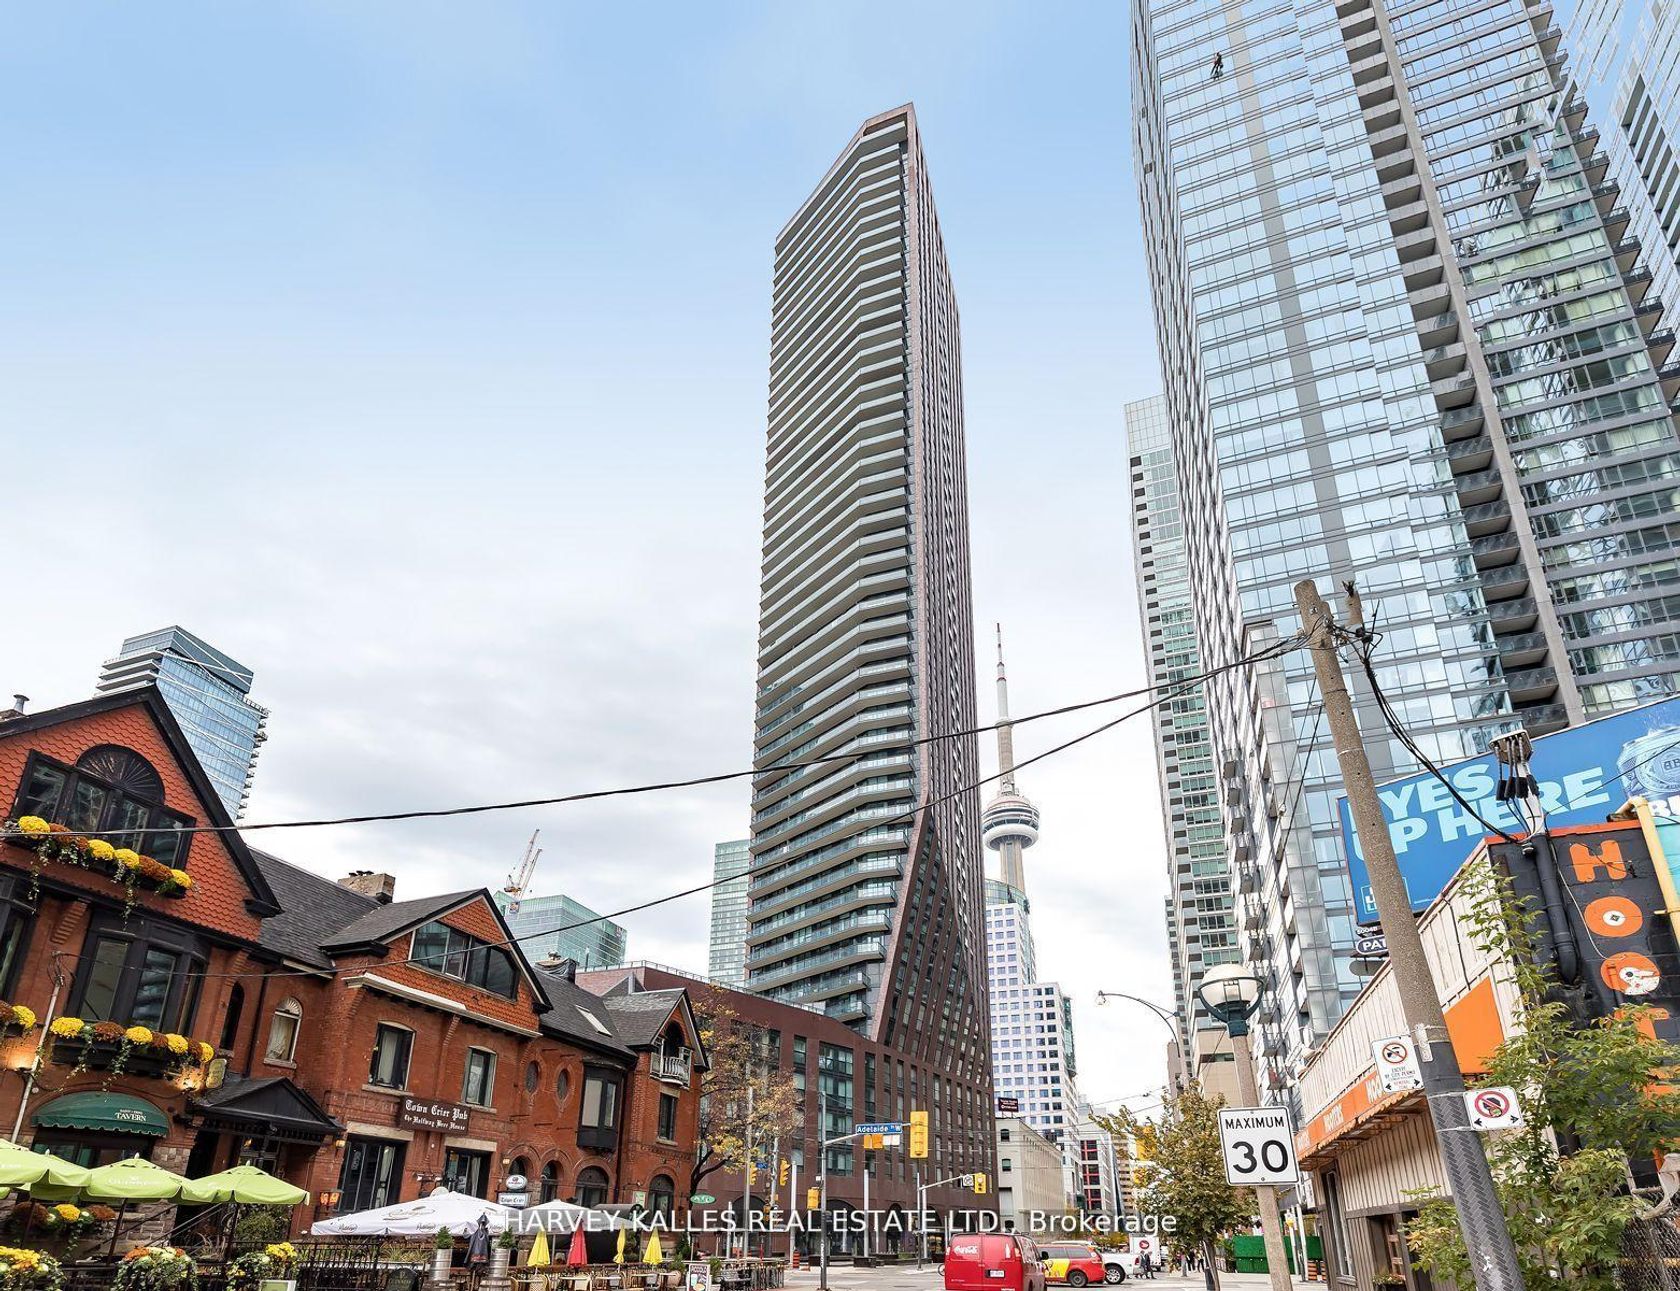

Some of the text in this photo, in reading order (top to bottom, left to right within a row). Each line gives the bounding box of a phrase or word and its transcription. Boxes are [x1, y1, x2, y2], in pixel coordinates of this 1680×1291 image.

[114, 1112, 147, 1122] TAVERN
[405, 1099, 468, 1121] Town Crier Pub
[857, 1125, 889, 1133] Adelaide
[1225, 1116, 1285, 1130] MAXIMUM
[1232, 1140, 1289, 1174] 30
